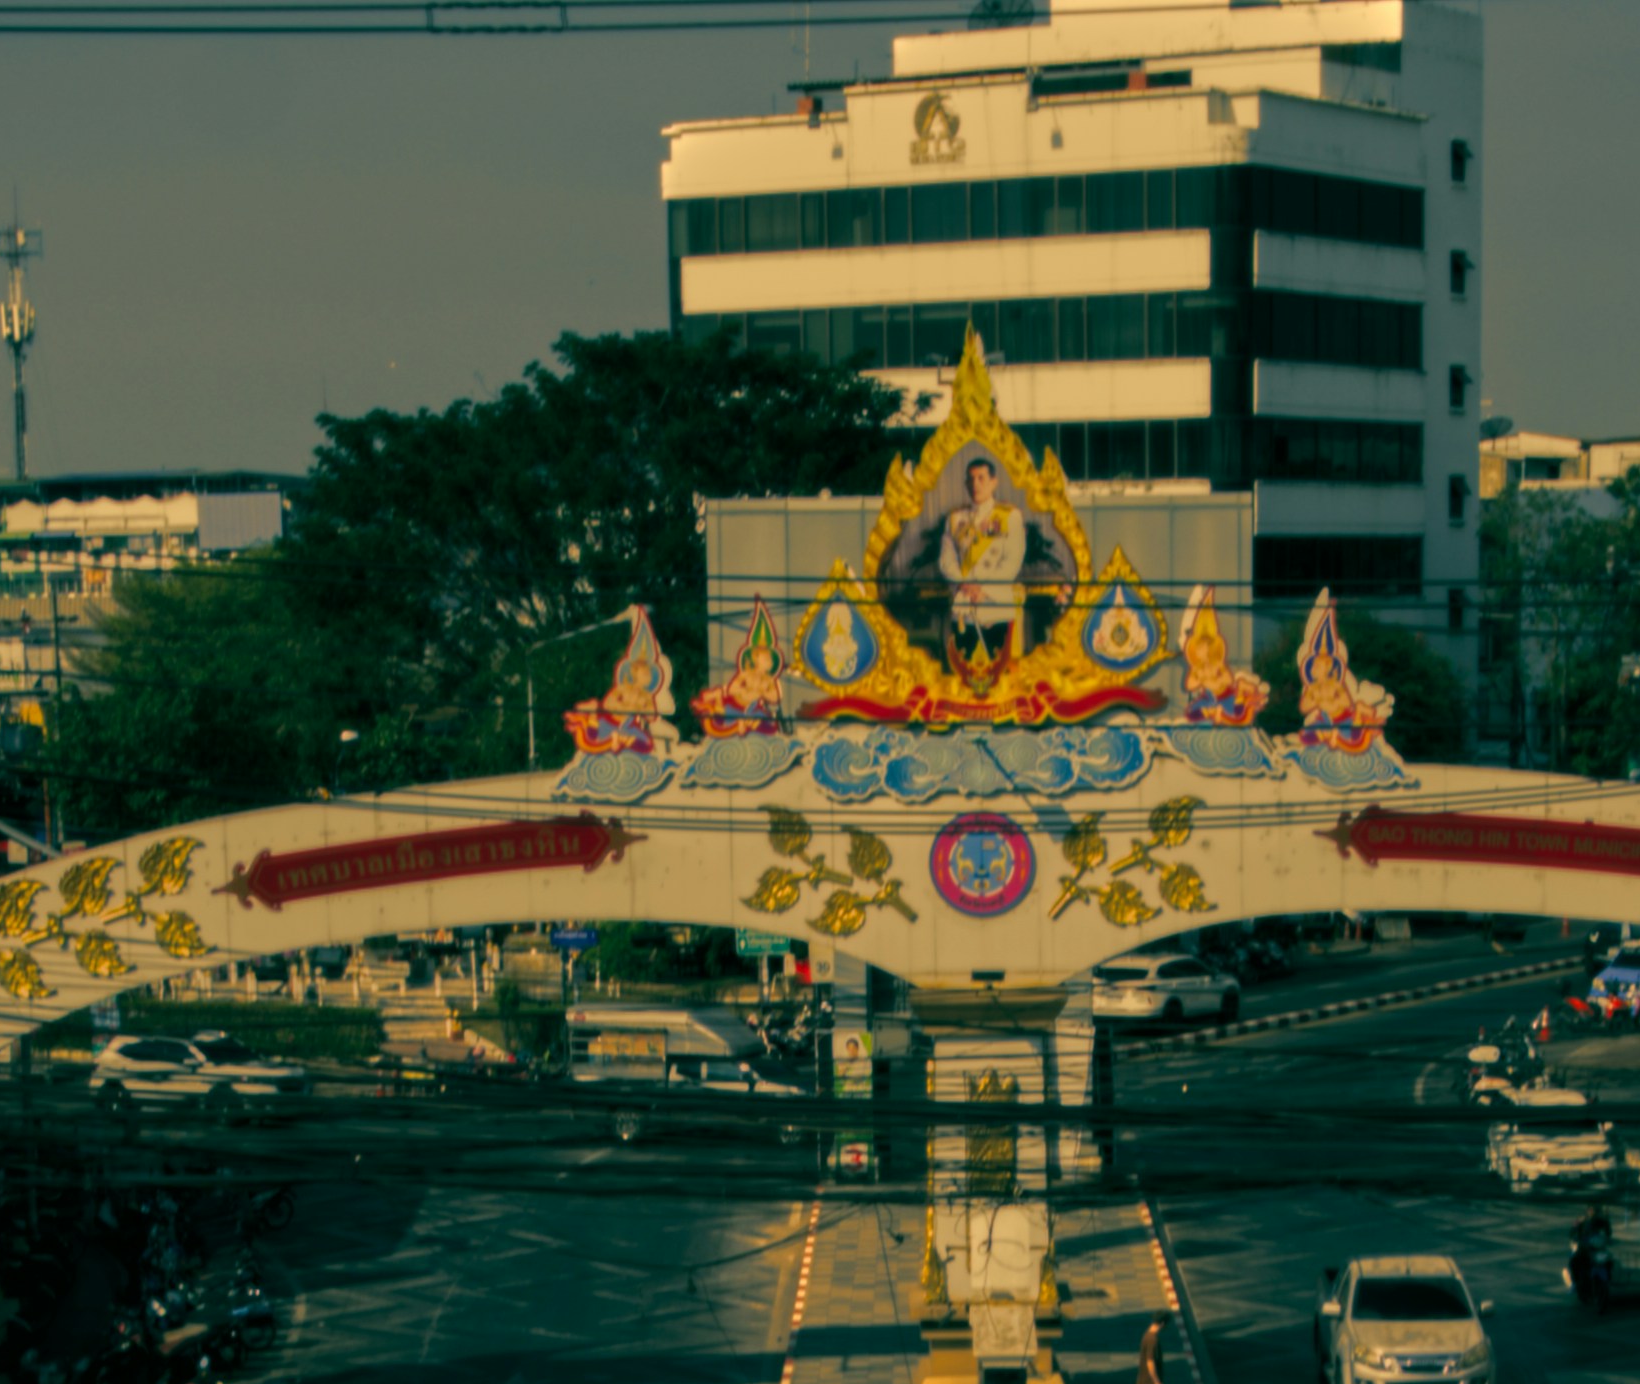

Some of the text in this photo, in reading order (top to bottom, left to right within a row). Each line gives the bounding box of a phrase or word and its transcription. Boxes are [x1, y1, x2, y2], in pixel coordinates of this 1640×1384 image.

[1413, 827, 1474, 847] THONG
[1479, 829, 1510, 850] HIN
[1516, 831, 1570, 855] TOWN
